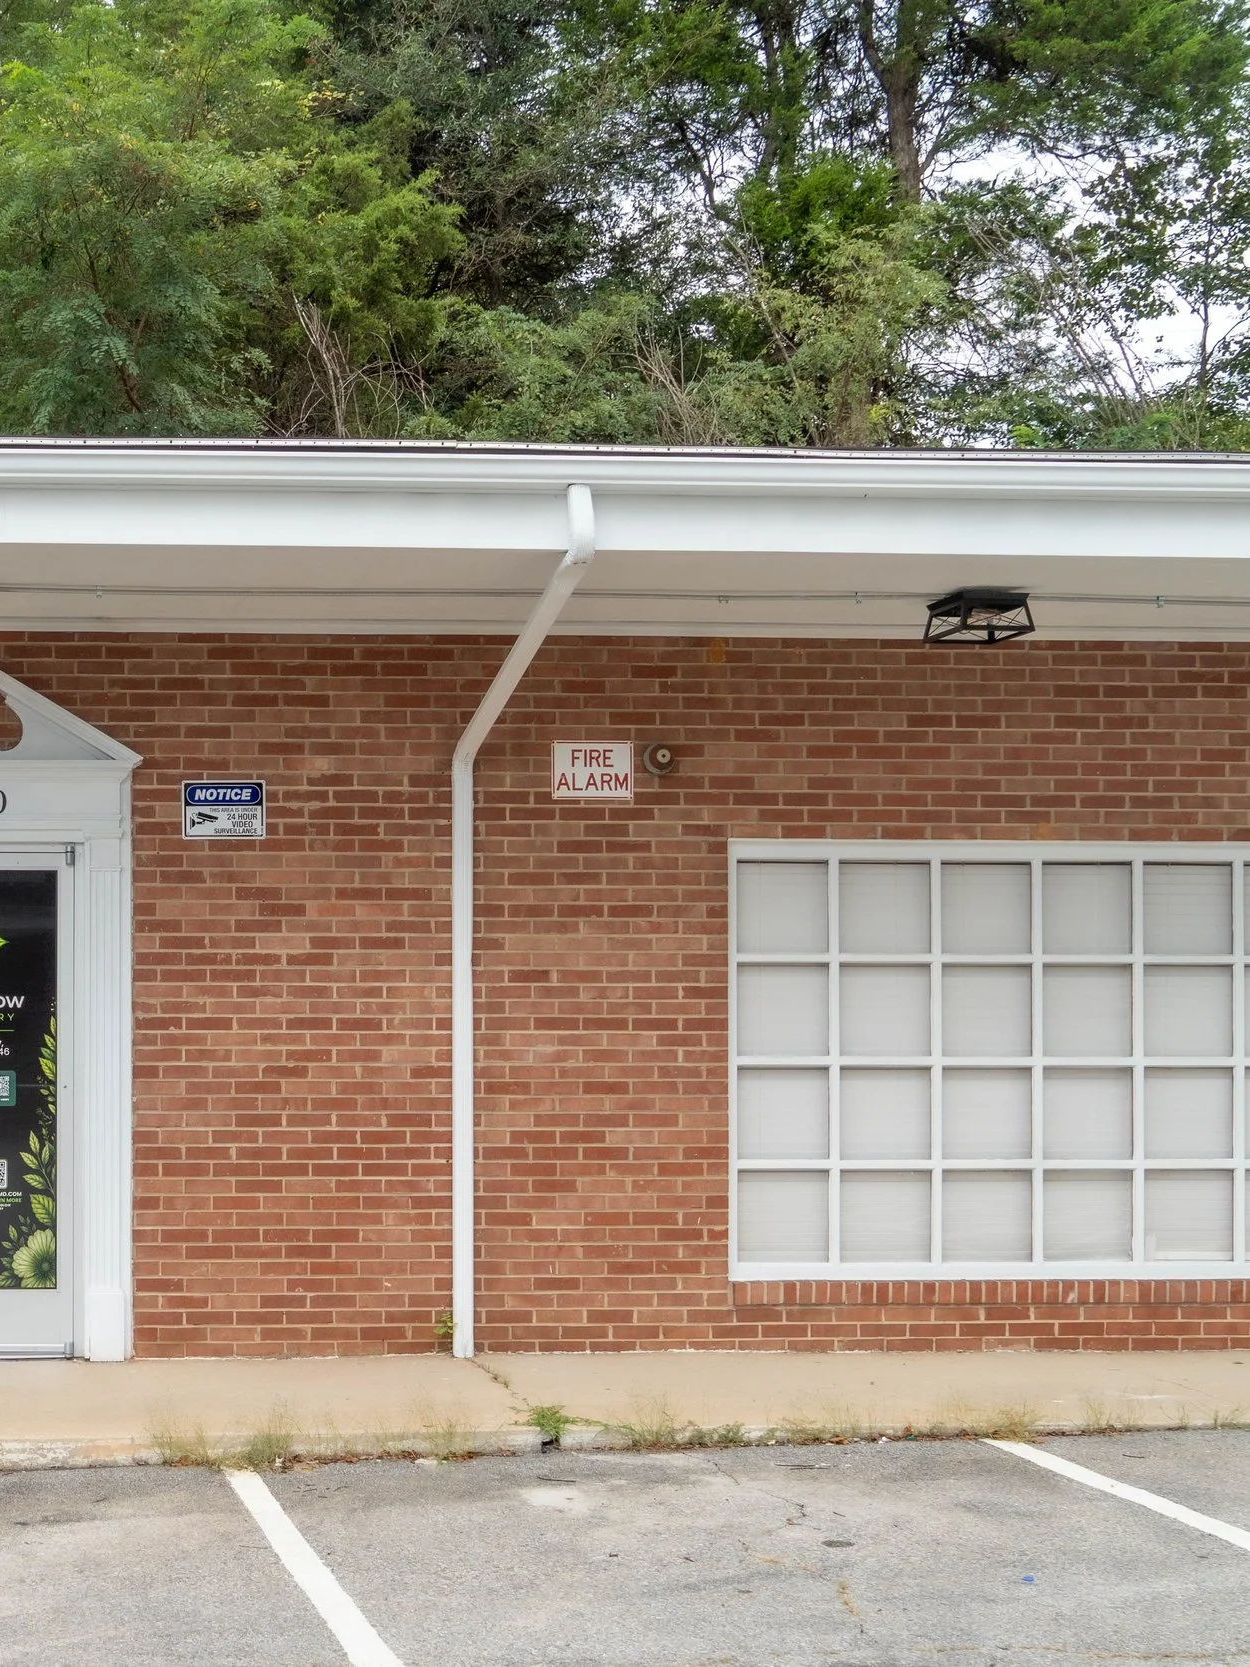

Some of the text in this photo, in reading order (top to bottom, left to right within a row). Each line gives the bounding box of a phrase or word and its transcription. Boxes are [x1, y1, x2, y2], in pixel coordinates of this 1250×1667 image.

[571, 749, 614, 768] FIRE
[556, 772, 629, 791] ALARM
[194, 788, 252, 801] NOTICE
